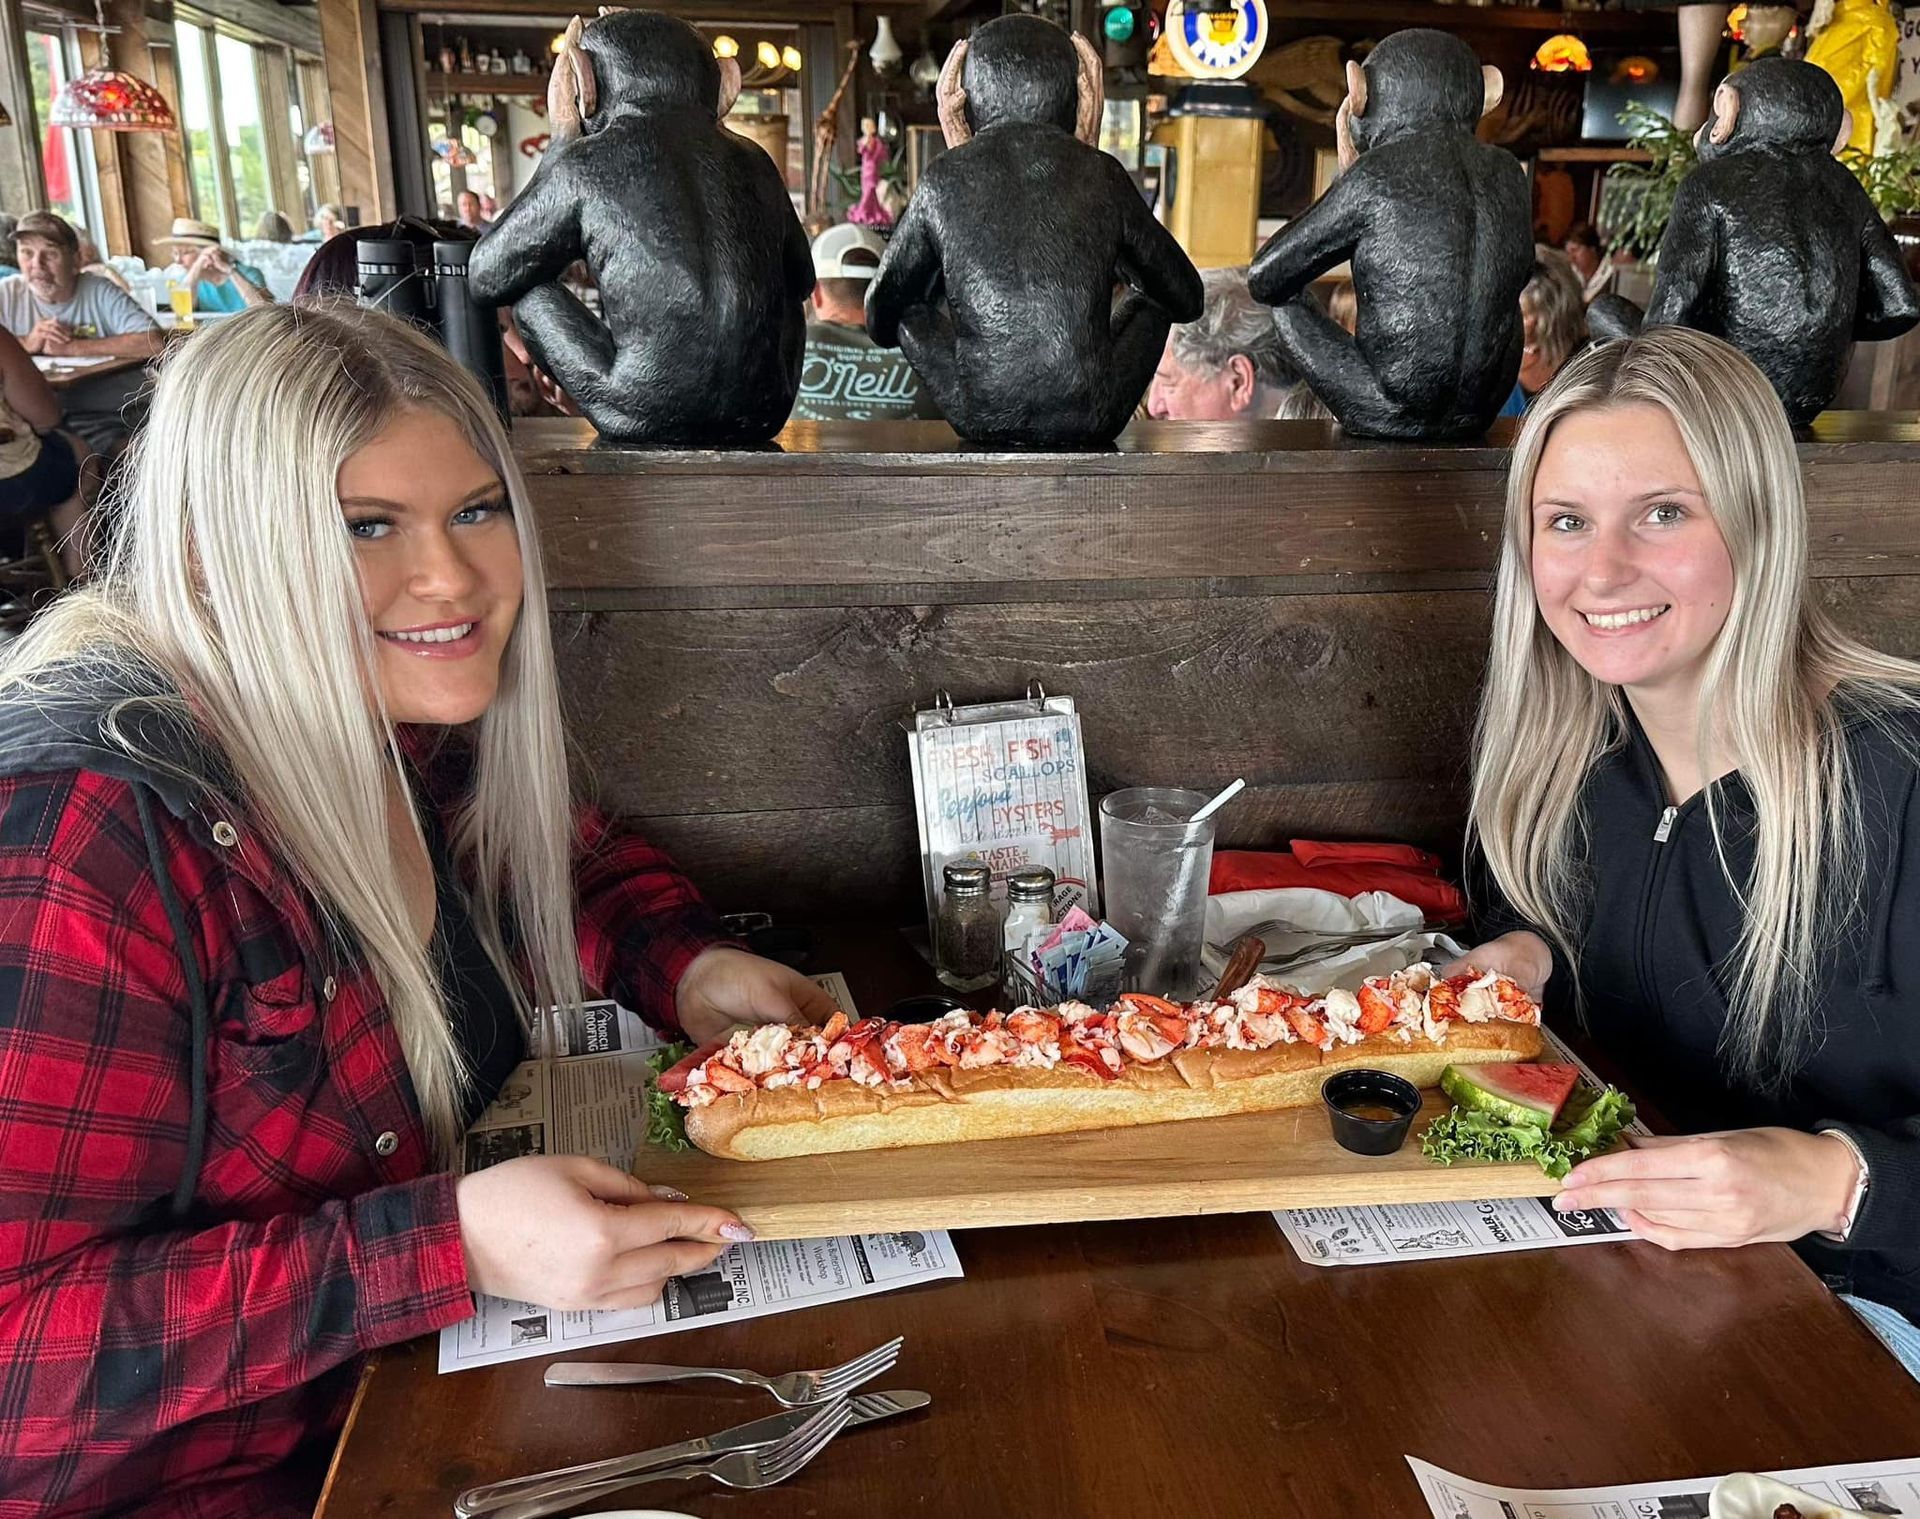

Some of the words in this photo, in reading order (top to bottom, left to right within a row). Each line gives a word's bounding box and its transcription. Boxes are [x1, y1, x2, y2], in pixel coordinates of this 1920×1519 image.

[800, 357, 918, 402] O'Neill
[983, 759, 1076, 784] SCALLOPS
[936, 783, 1013, 823] Seafood
[980, 846, 1020, 860] TASTE
[989, 856, 1030, 871] MAINE
[1053, 886, 1073, 907] RAGE
[1056, 891, 1082, 923] CTIONS
[585, 1011, 599, 1052] ROOFING
[597, 1020, 609, 1050] HORCH
[1482, 1216, 1509, 1242] KOHLER
[730, 1264, 747, 1287] TIRE
[812, 1246, 829, 1280] Workshop
[734, 1286, 750, 1307] INC.
